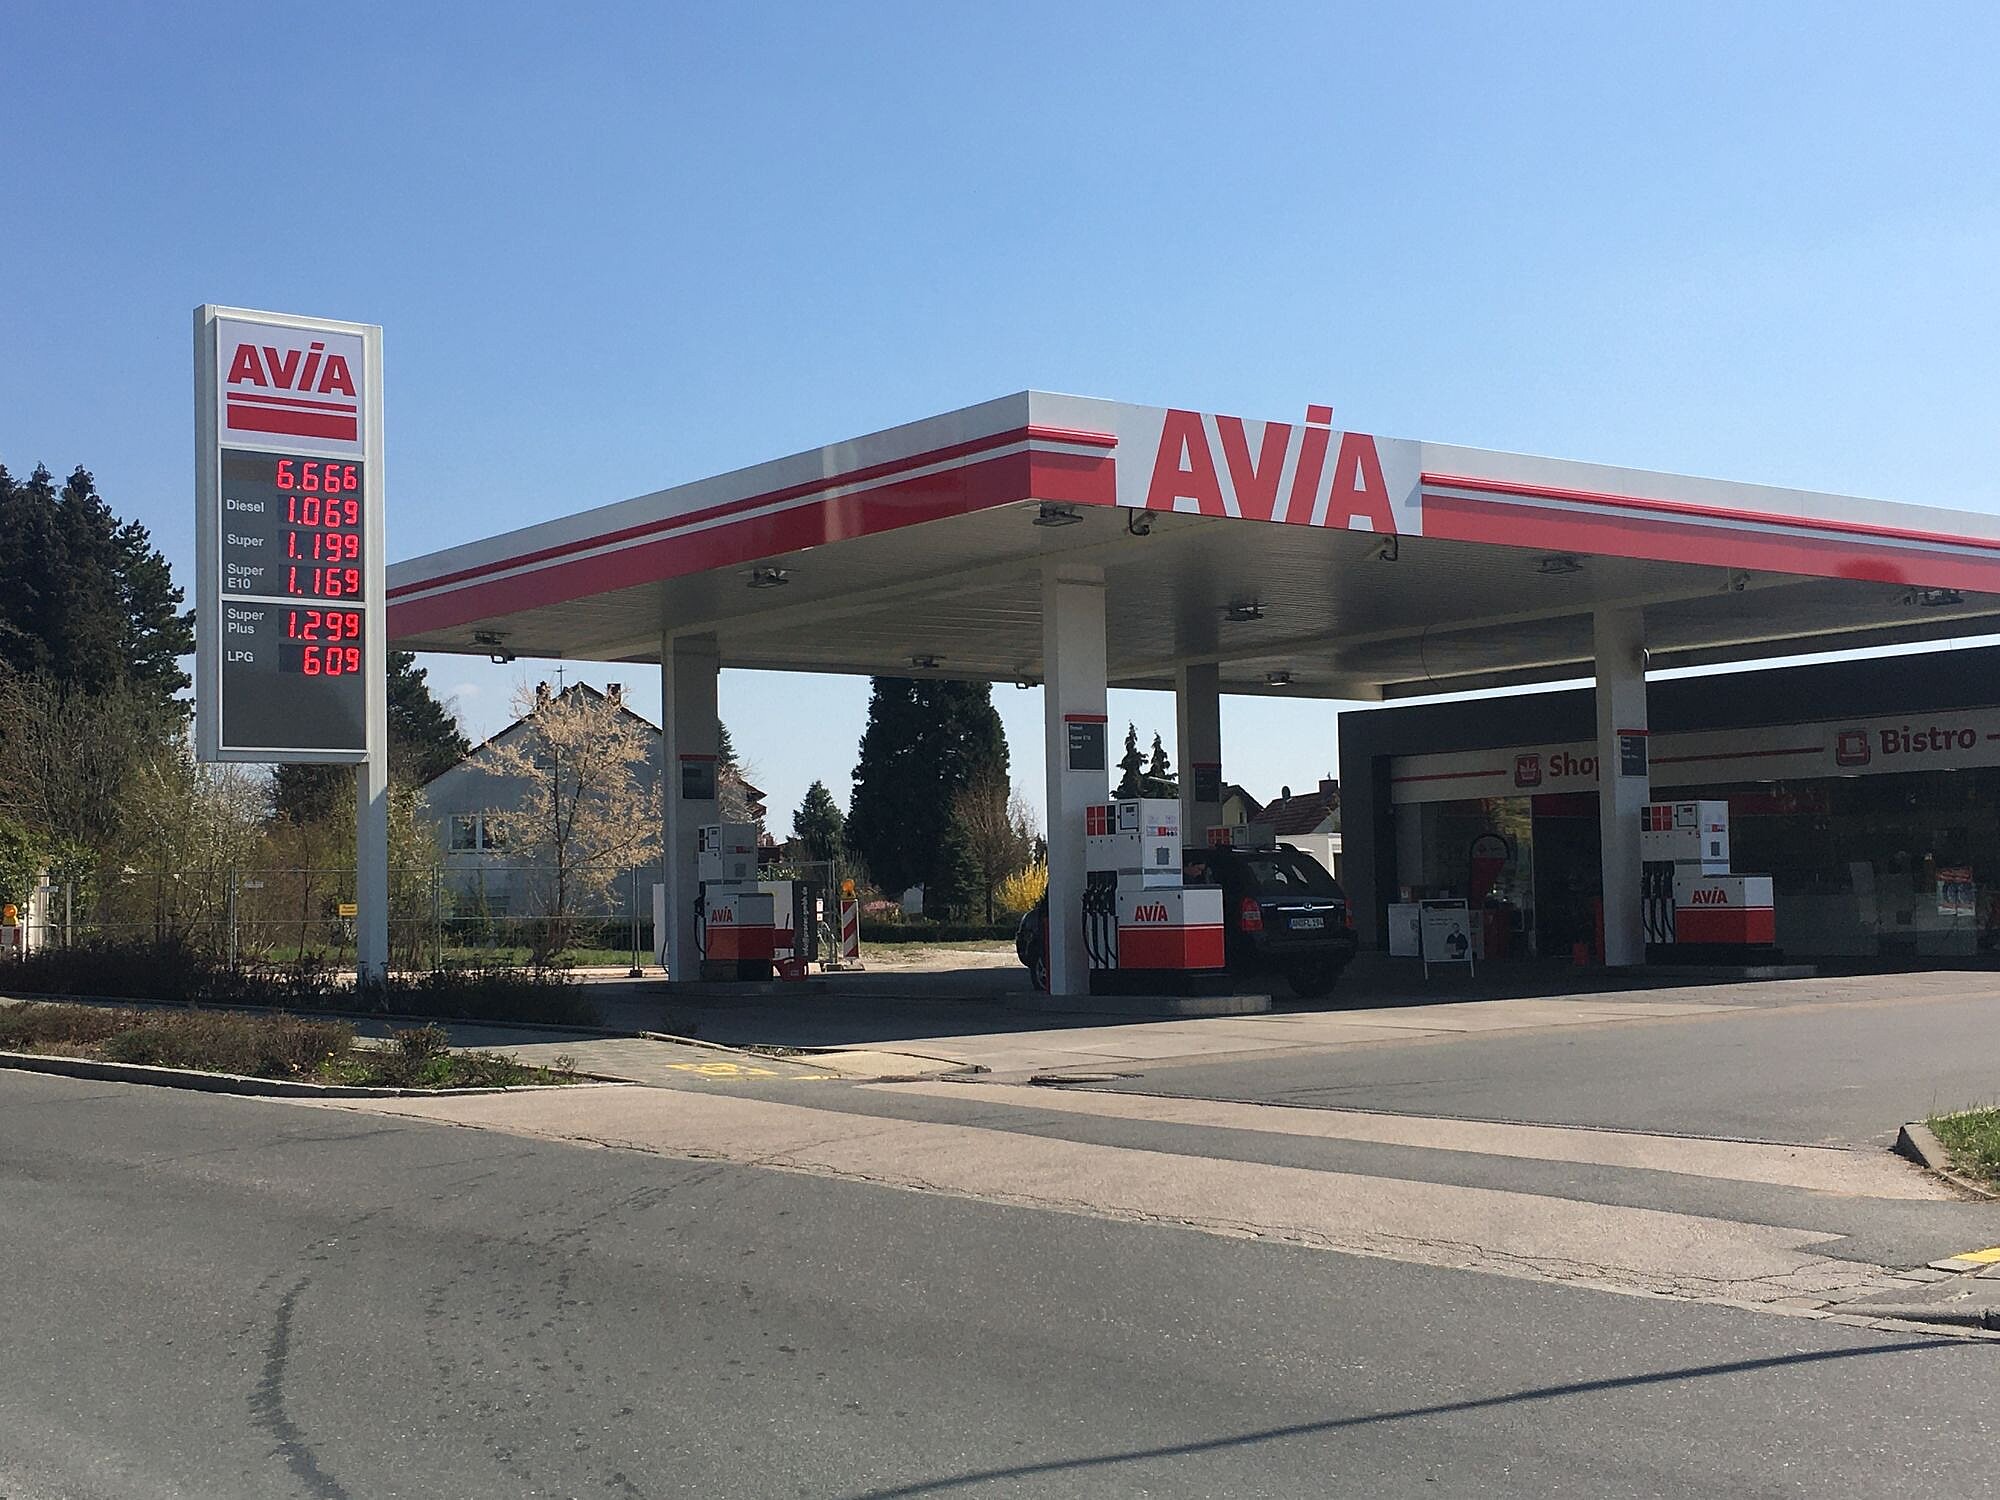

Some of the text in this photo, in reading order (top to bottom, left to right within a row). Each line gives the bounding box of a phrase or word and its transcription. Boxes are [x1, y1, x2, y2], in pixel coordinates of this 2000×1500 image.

[277, 459, 358, 493] 6.666
[227, 499, 264, 513] Diesel
[288, 496, 359, 528] 1.069
[227, 533, 264, 547] Super
[288, 531, 359, 562] 1.199
[227, 563, 264, 576] Super
[227, 577, 251, 589] E10
[288, 566, 359, 597] 1.169
[227, 608, 264, 621] Super
[228, 622, 255, 634] Plus
[289, 611, 359, 641] 1.299
[227, 650, 254, 662] LPG
[303, 645, 360, 676] 609
[1879, 725, 1977, 754] Bistro
